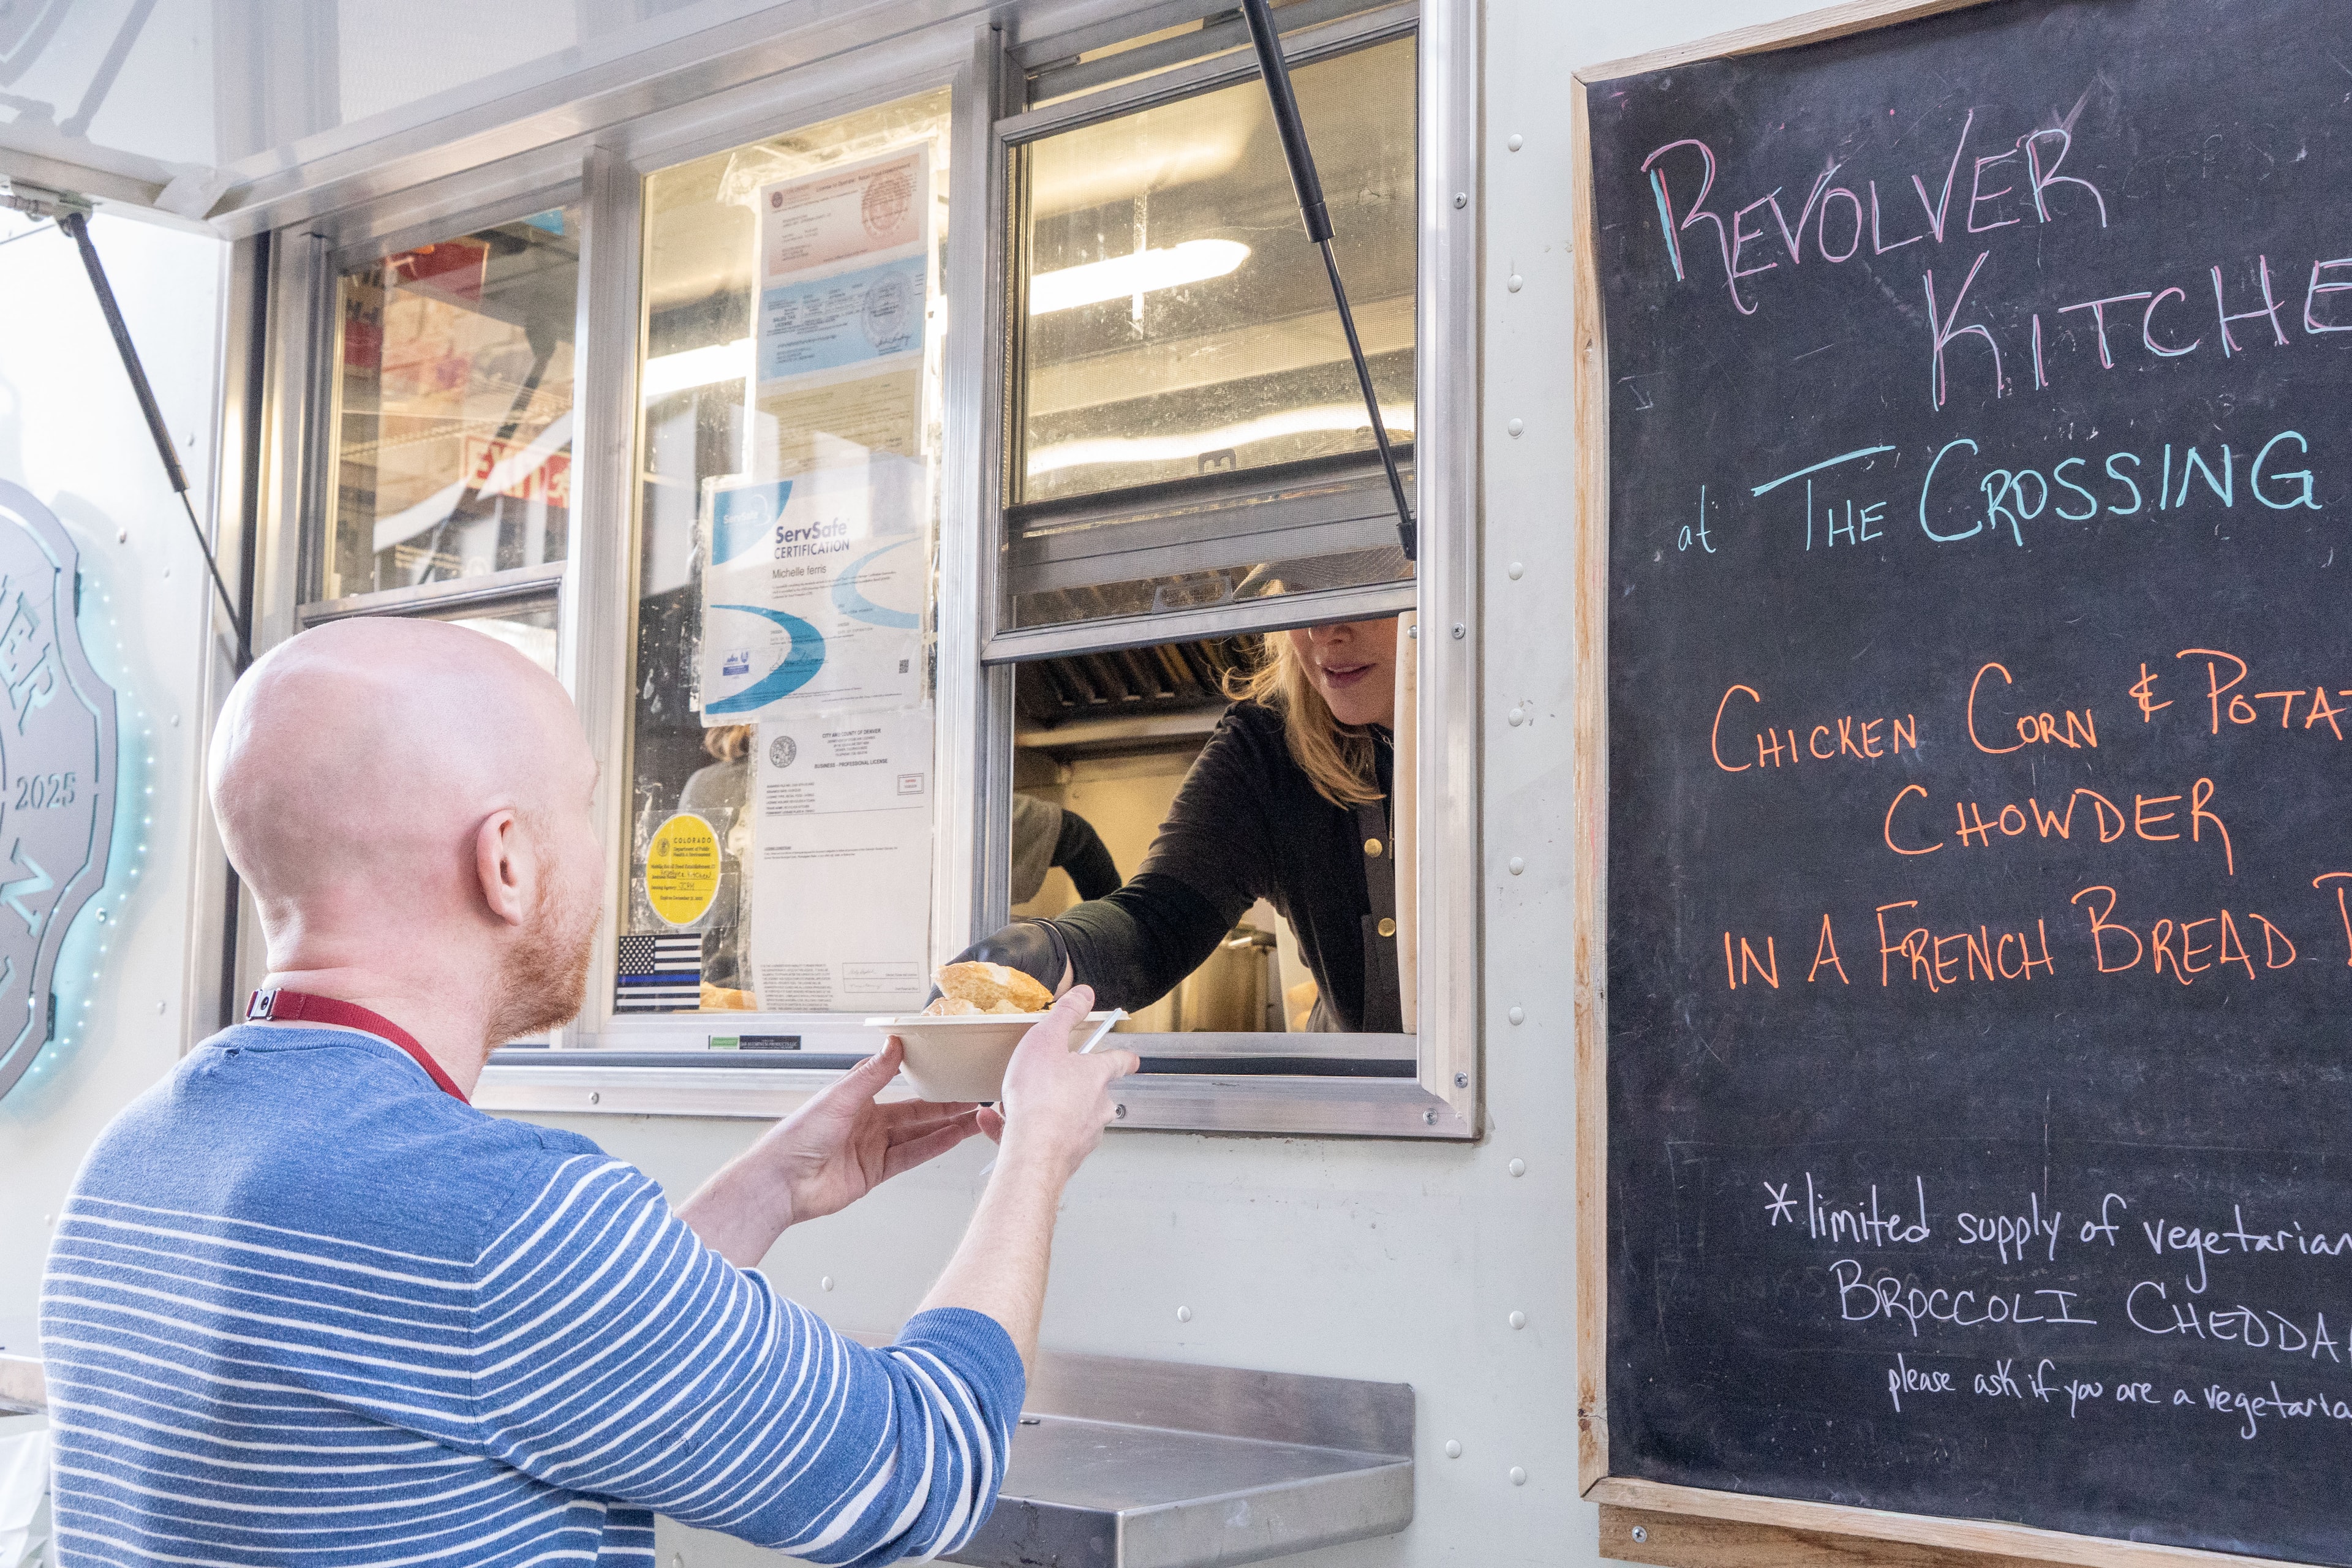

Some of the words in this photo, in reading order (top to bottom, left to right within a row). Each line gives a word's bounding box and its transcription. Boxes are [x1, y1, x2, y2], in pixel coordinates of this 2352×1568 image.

[1642, 109, 2108, 315] REVOLVER
[1923, 251, 2352, 411] KITCHE
[775, 517, 848, 545] ServSafe
[1678, 486, 1716, 552] at
[1752, 445, 1895, 549] THE
[1920, 431, 2322, 546] CROSSING
[772, 568, 804, 579] Michelle
[807, 565, 827, 576] ferris
[774, 539, 850, 560] CERTIFICATION
[1712, 685, 1917, 772] CHICKEN
[1967, 662, 2097, 753] CORN
[15, 772, 76, 811] 2025
[1885, 778, 2233, 875] CHOWDER
[1724, 932, 1779, 989] IN
[1808, 914, 1849, 984] A
[1877, 900, 2053, 992] FRENCH
[2071, 886, 2296, 985] BREAD
[1958, 1193, 2060, 1264] supply
[2081, 1193, 2126, 1245] of
[2127, 1281, 2352, 1362] CHEDDA
[1888, 1354, 1954, 1411] please
[1974, 1359, 2025, 1398] ask
[2029, 1359, 2057, 1402] if
[2065, 1381, 2103, 1417] you
[2116, 1382, 2161, 1403] are
[2173, 1389, 2195, 1405] a
